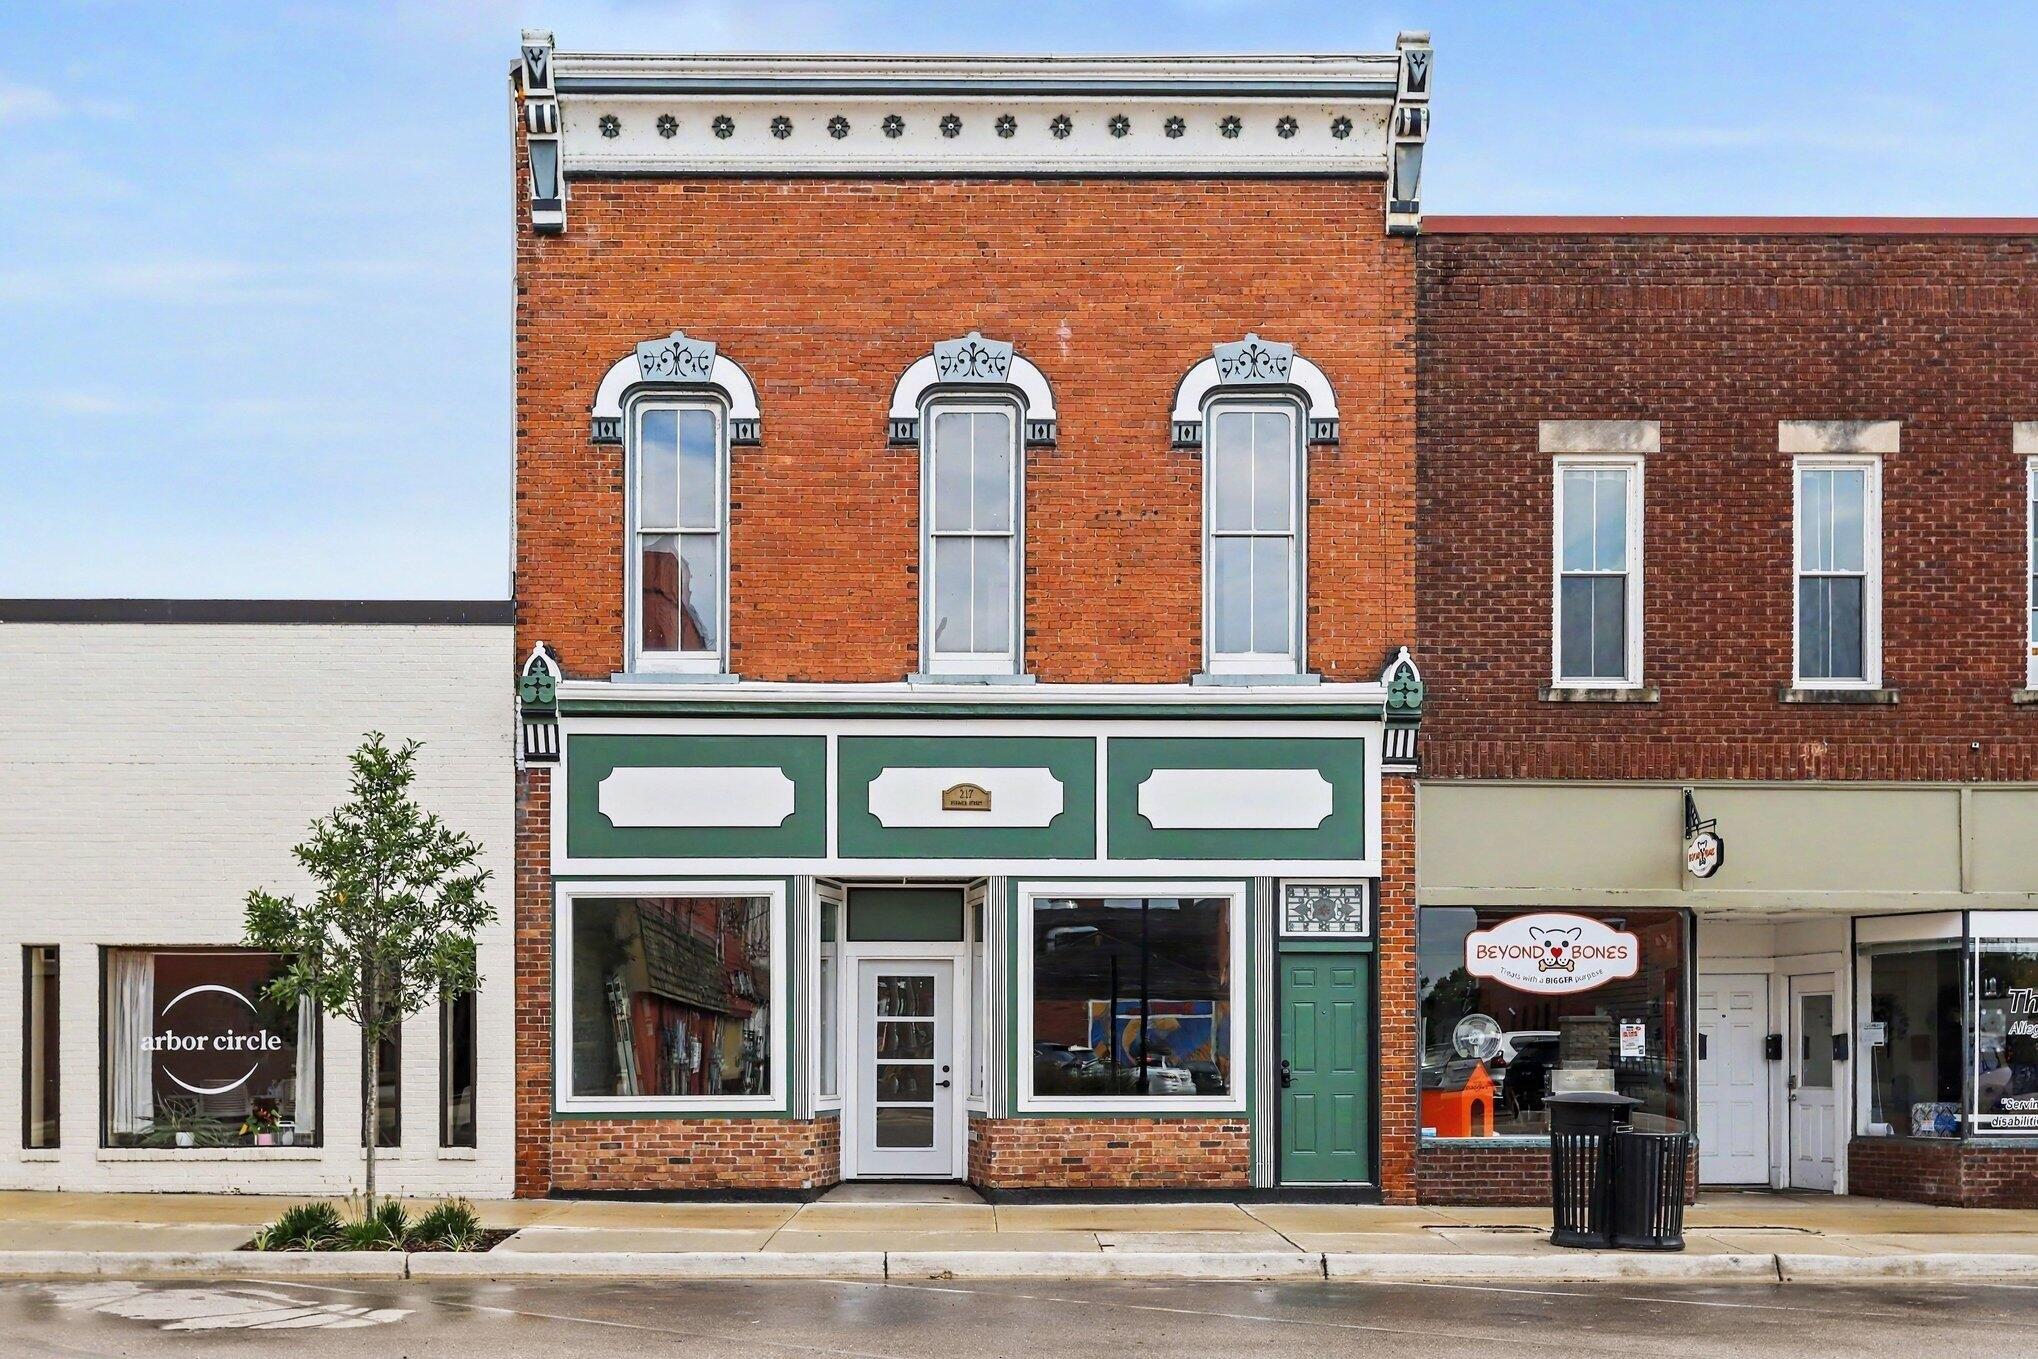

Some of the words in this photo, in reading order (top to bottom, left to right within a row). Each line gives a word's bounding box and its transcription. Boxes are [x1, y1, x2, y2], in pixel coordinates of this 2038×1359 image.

[959, 789, 974, 799] 217
[1476, 944, 1545, 960] BEYOND
[1571, 944, 1628, 960] BONES
[1500, 966, 1521, 980] Treats
[1522, 975, 1538, 984] with
[1545, 976, 1573, 985] BIGGER
[1574, 968, 1603, 984] purpose
[141, 1029, 209, 1051] arbor
[213, 1029, 282, 1051] circle
[1991, 1115, 2038, 1128] disabiliti
